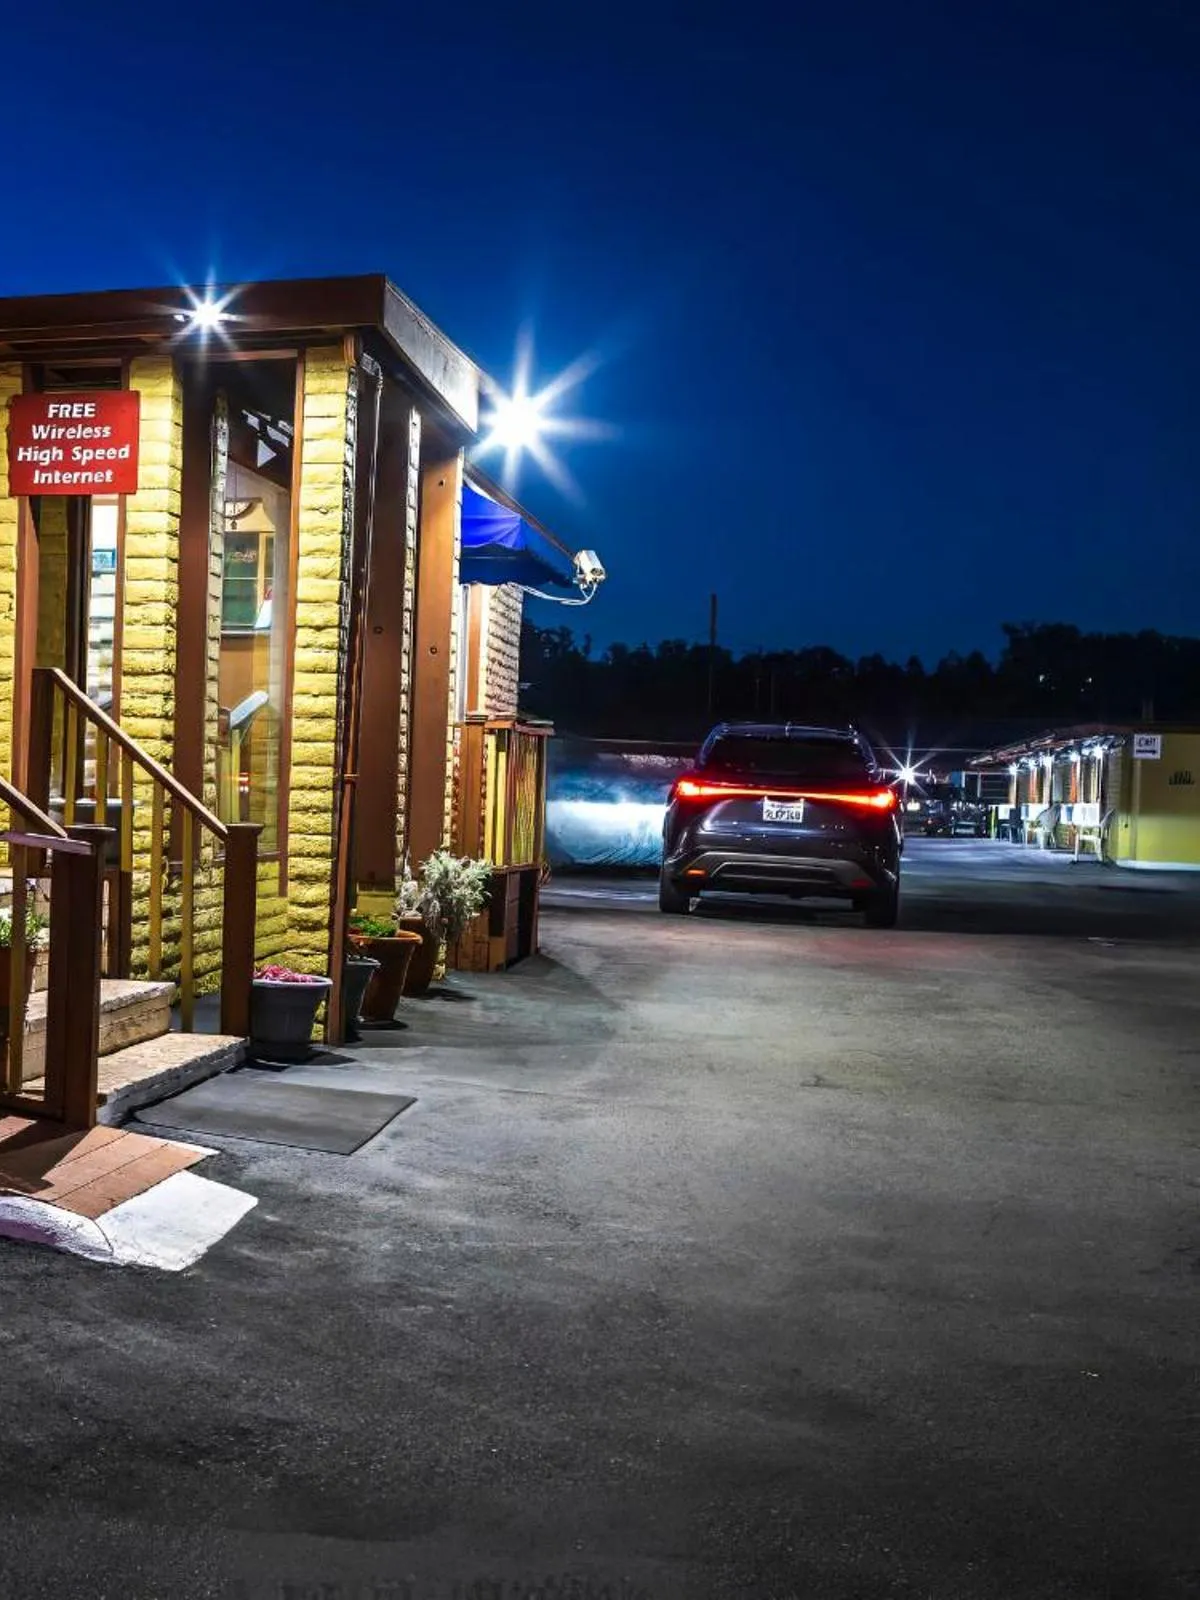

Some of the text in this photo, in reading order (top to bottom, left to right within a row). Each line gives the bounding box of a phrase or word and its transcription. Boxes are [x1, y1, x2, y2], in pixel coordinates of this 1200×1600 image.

[47, 403, 96, 418] FREE
[31, 424, 111, 439] Wireless
[17, 445, 130, 465] High Speed
[33, 470, 113, 484] Internet
